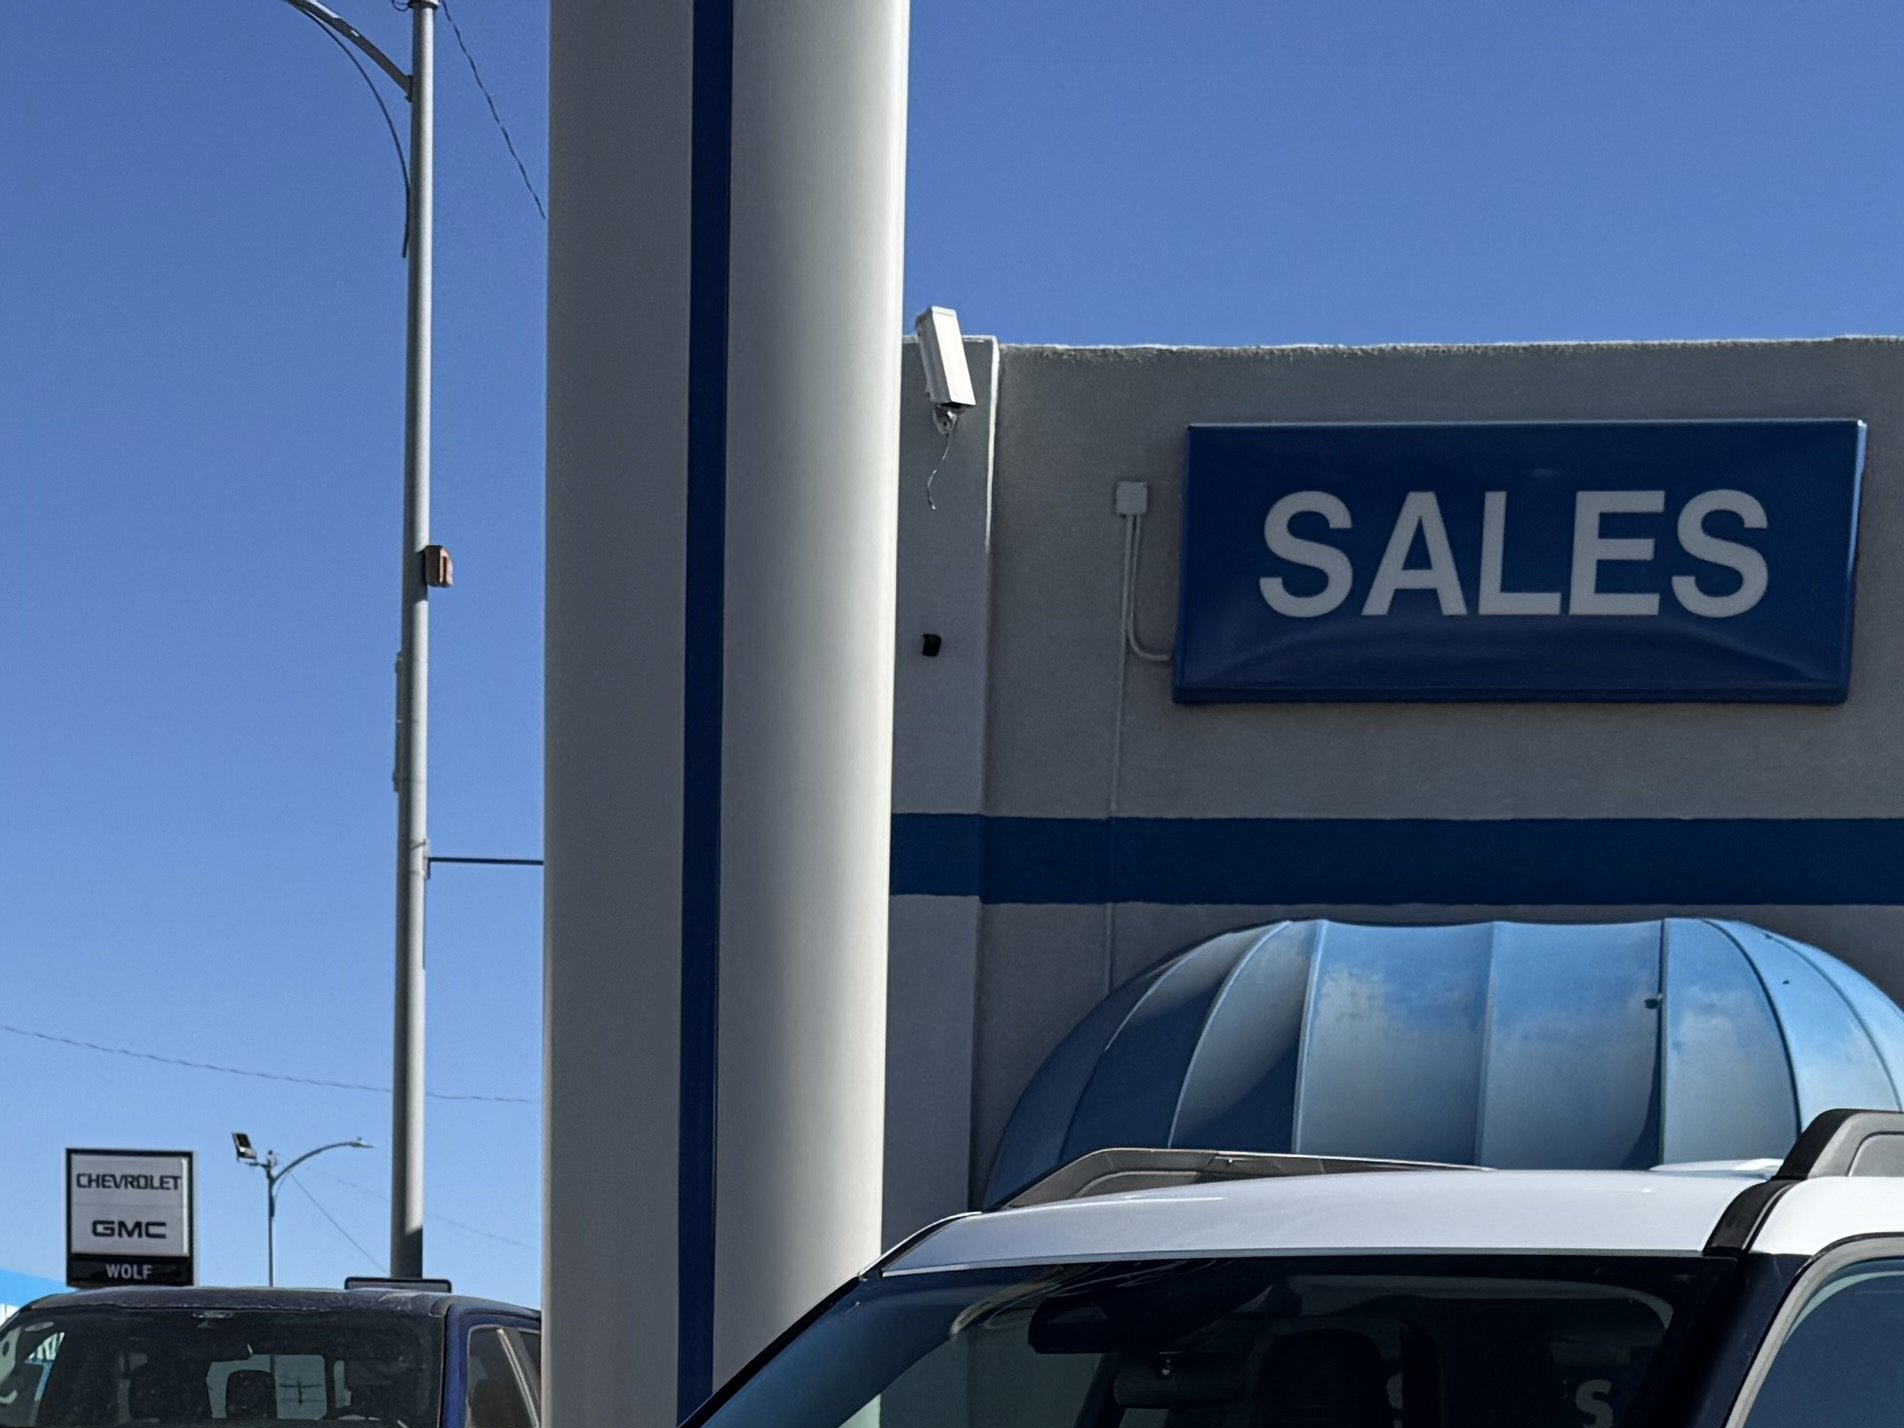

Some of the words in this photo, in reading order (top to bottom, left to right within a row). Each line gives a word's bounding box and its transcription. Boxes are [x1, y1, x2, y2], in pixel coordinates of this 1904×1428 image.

[1258, 487, 1770, 619] SALES
[75, 1172, 181, 1191] CHEVROLET
[91, 1219, 167, 1240] GMC
[104, 1263, 154, 1280] WOLF
